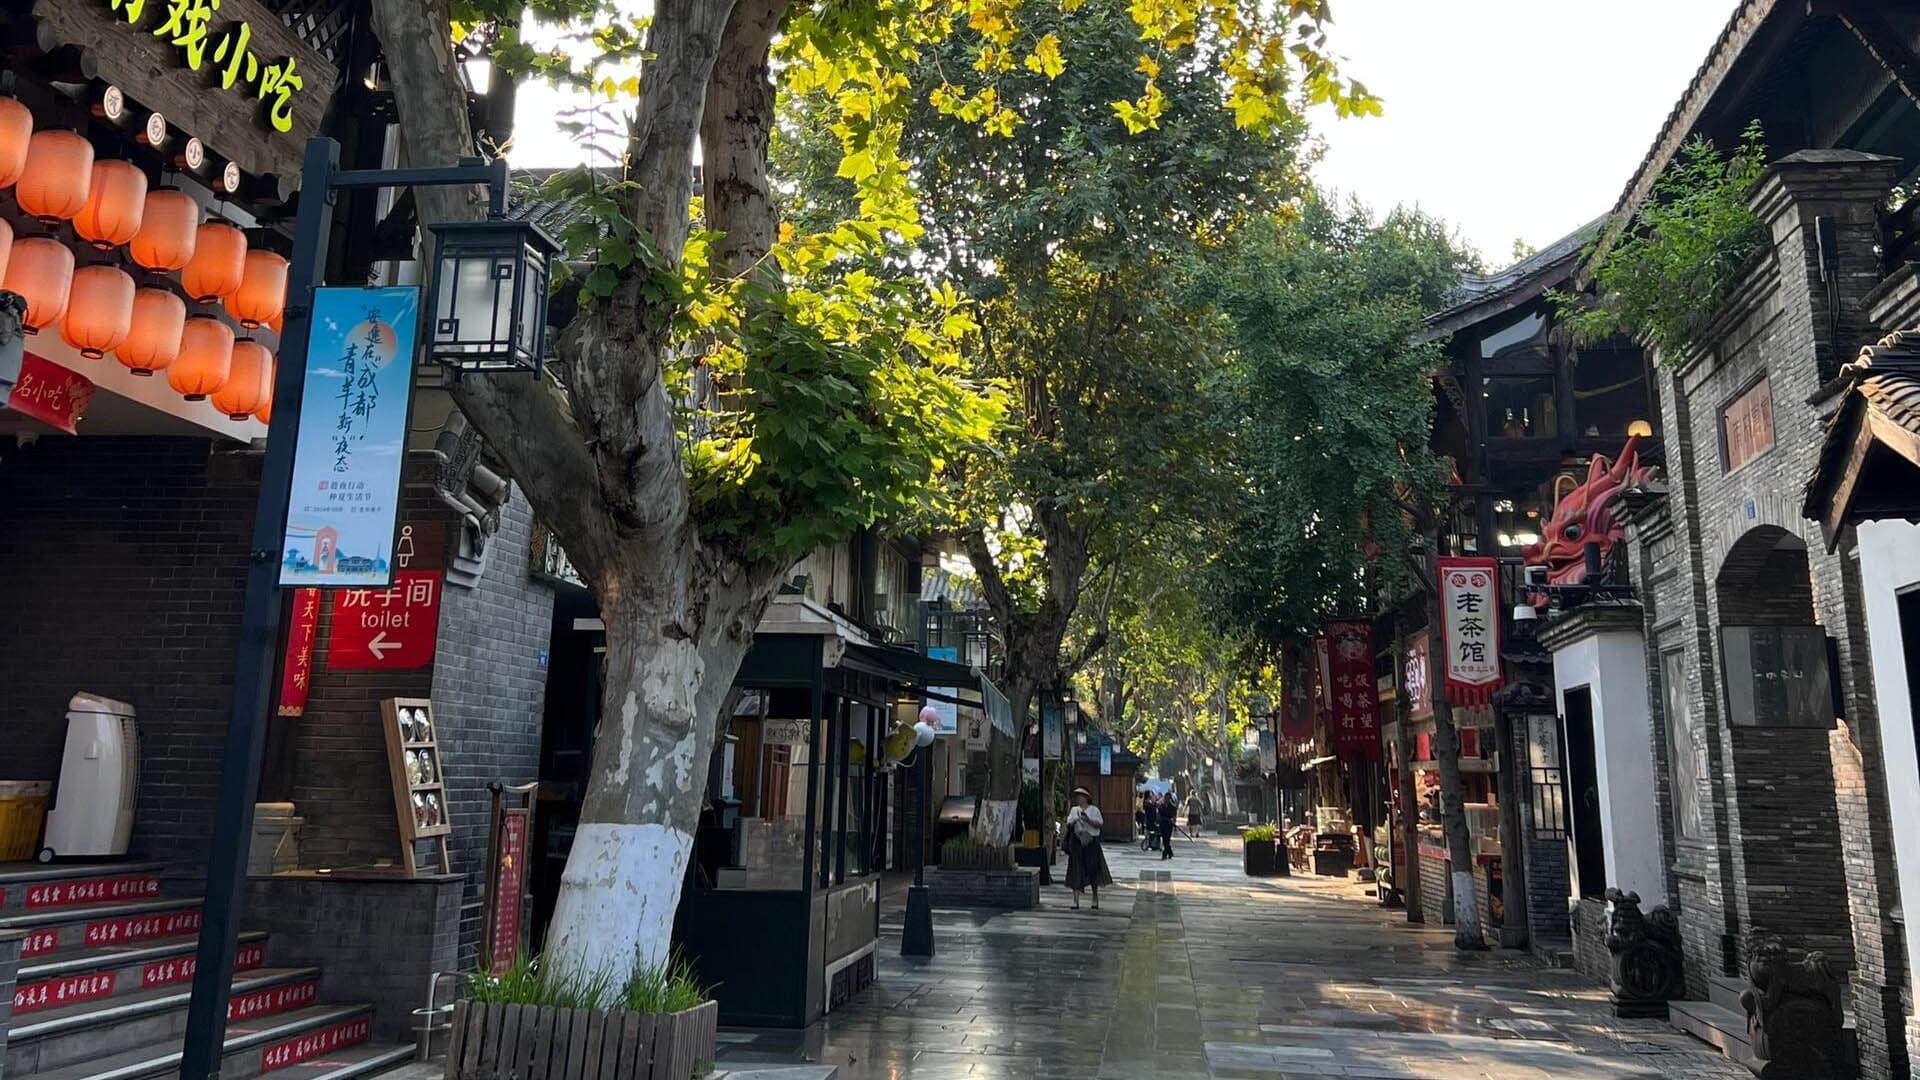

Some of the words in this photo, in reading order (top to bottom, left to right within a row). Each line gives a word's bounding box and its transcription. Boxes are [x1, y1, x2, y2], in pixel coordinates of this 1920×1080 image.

[342, 578, 433, 607] 洗手间
[361, 611, 410, 627] toilet
[1456, 592, 1485, 662] 老茶馆
[1342, 713, 1373, 729] 打望
